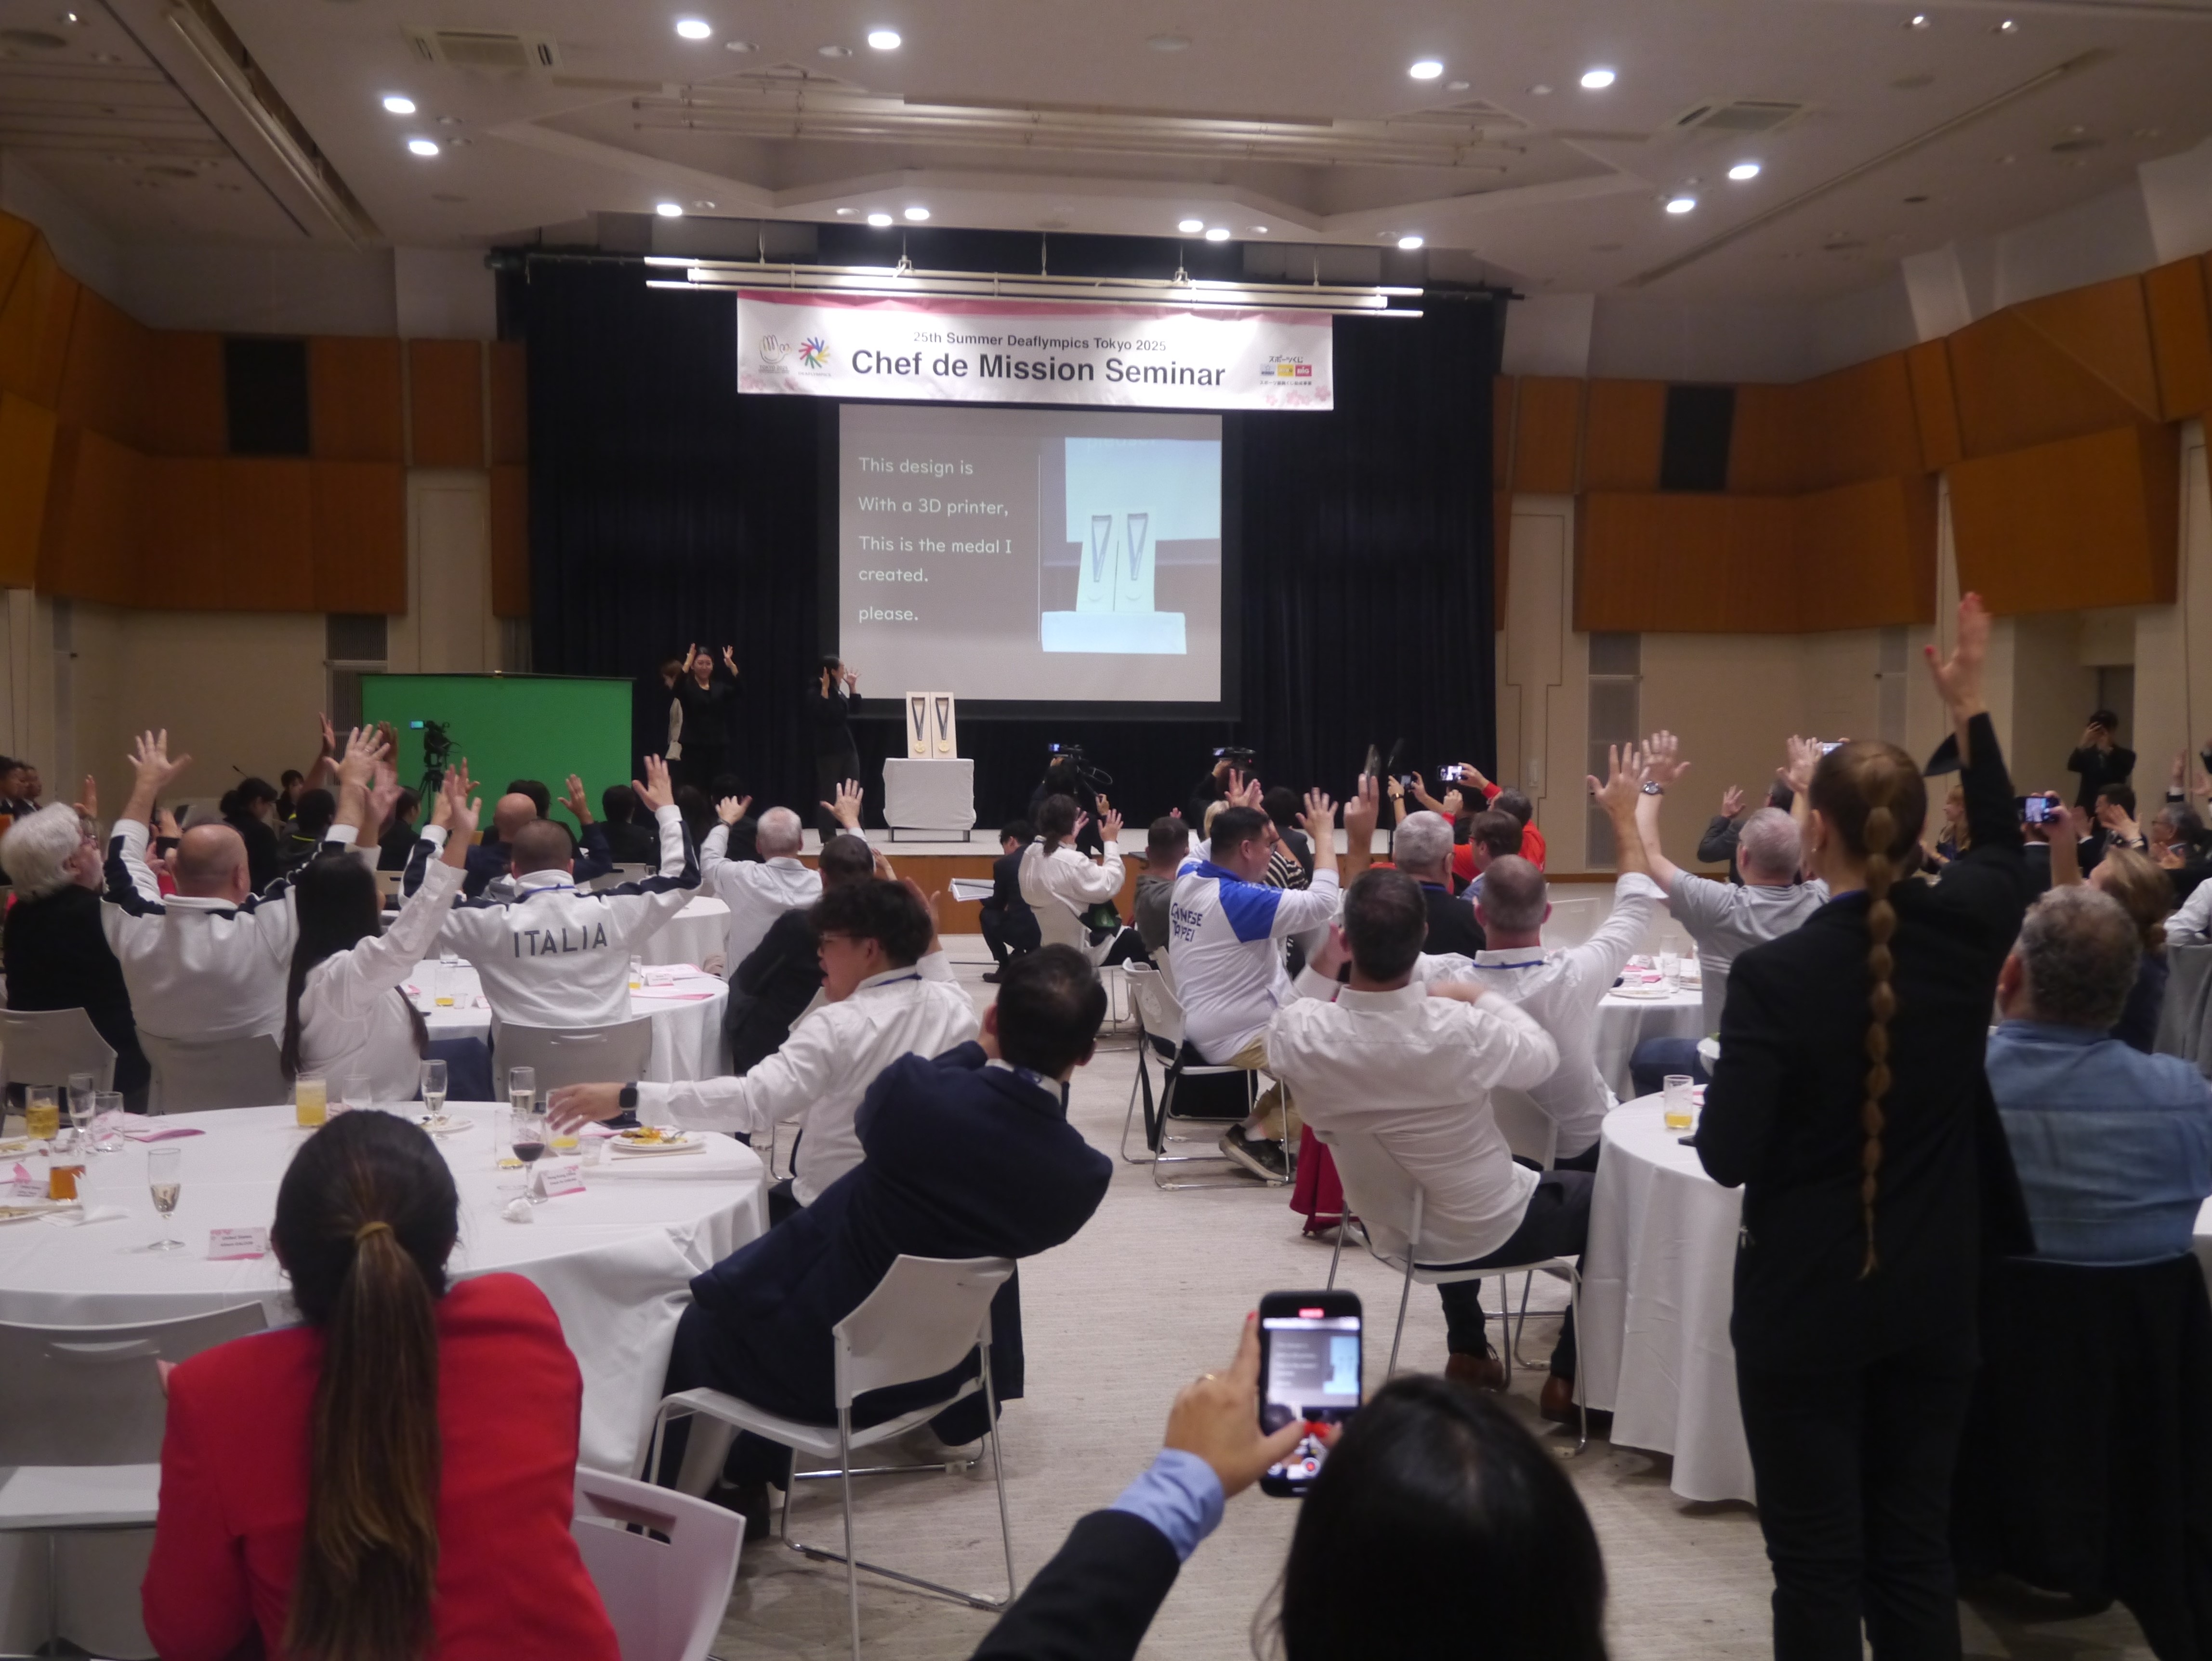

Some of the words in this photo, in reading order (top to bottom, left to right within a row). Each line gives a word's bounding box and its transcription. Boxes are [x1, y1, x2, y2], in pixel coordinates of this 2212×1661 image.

[913, 331, 942, 343] 25th
[947, 332, 1003, 345] Summer
[1008, 335, 1089, 350] Deaflympics
[1094, 337, 1132, 352] Tokyo
[1136, 339, 1166, 351] 2025
[852, 350, 922, 375] Chef
[933, 353, 968, 377] de
[980, 353, 1094, 381] Mission
[1106, 357, 1225, 386] Seminar
[859, 457, 894, 472] This
[900, 459, 954, 477] design
[961, 461, 974, 475] is
[859, 497, 896, 512] With
[902, 501, 912, 512] a
[919, 498, 941, 512] 3D
[948, 500, 1008, 517] printer,
[859, 536, 894, 551] This
[900, 537, 913, 552] is
[919, 538, 946, 553] the
[952, 539, 1000, 554] medal
[1005, 539, 1012, 554] I
[859, 568, 928, 582] created.
[859, 606, 919, 623] please.
[514, 923, 607, 958] ITALIA
